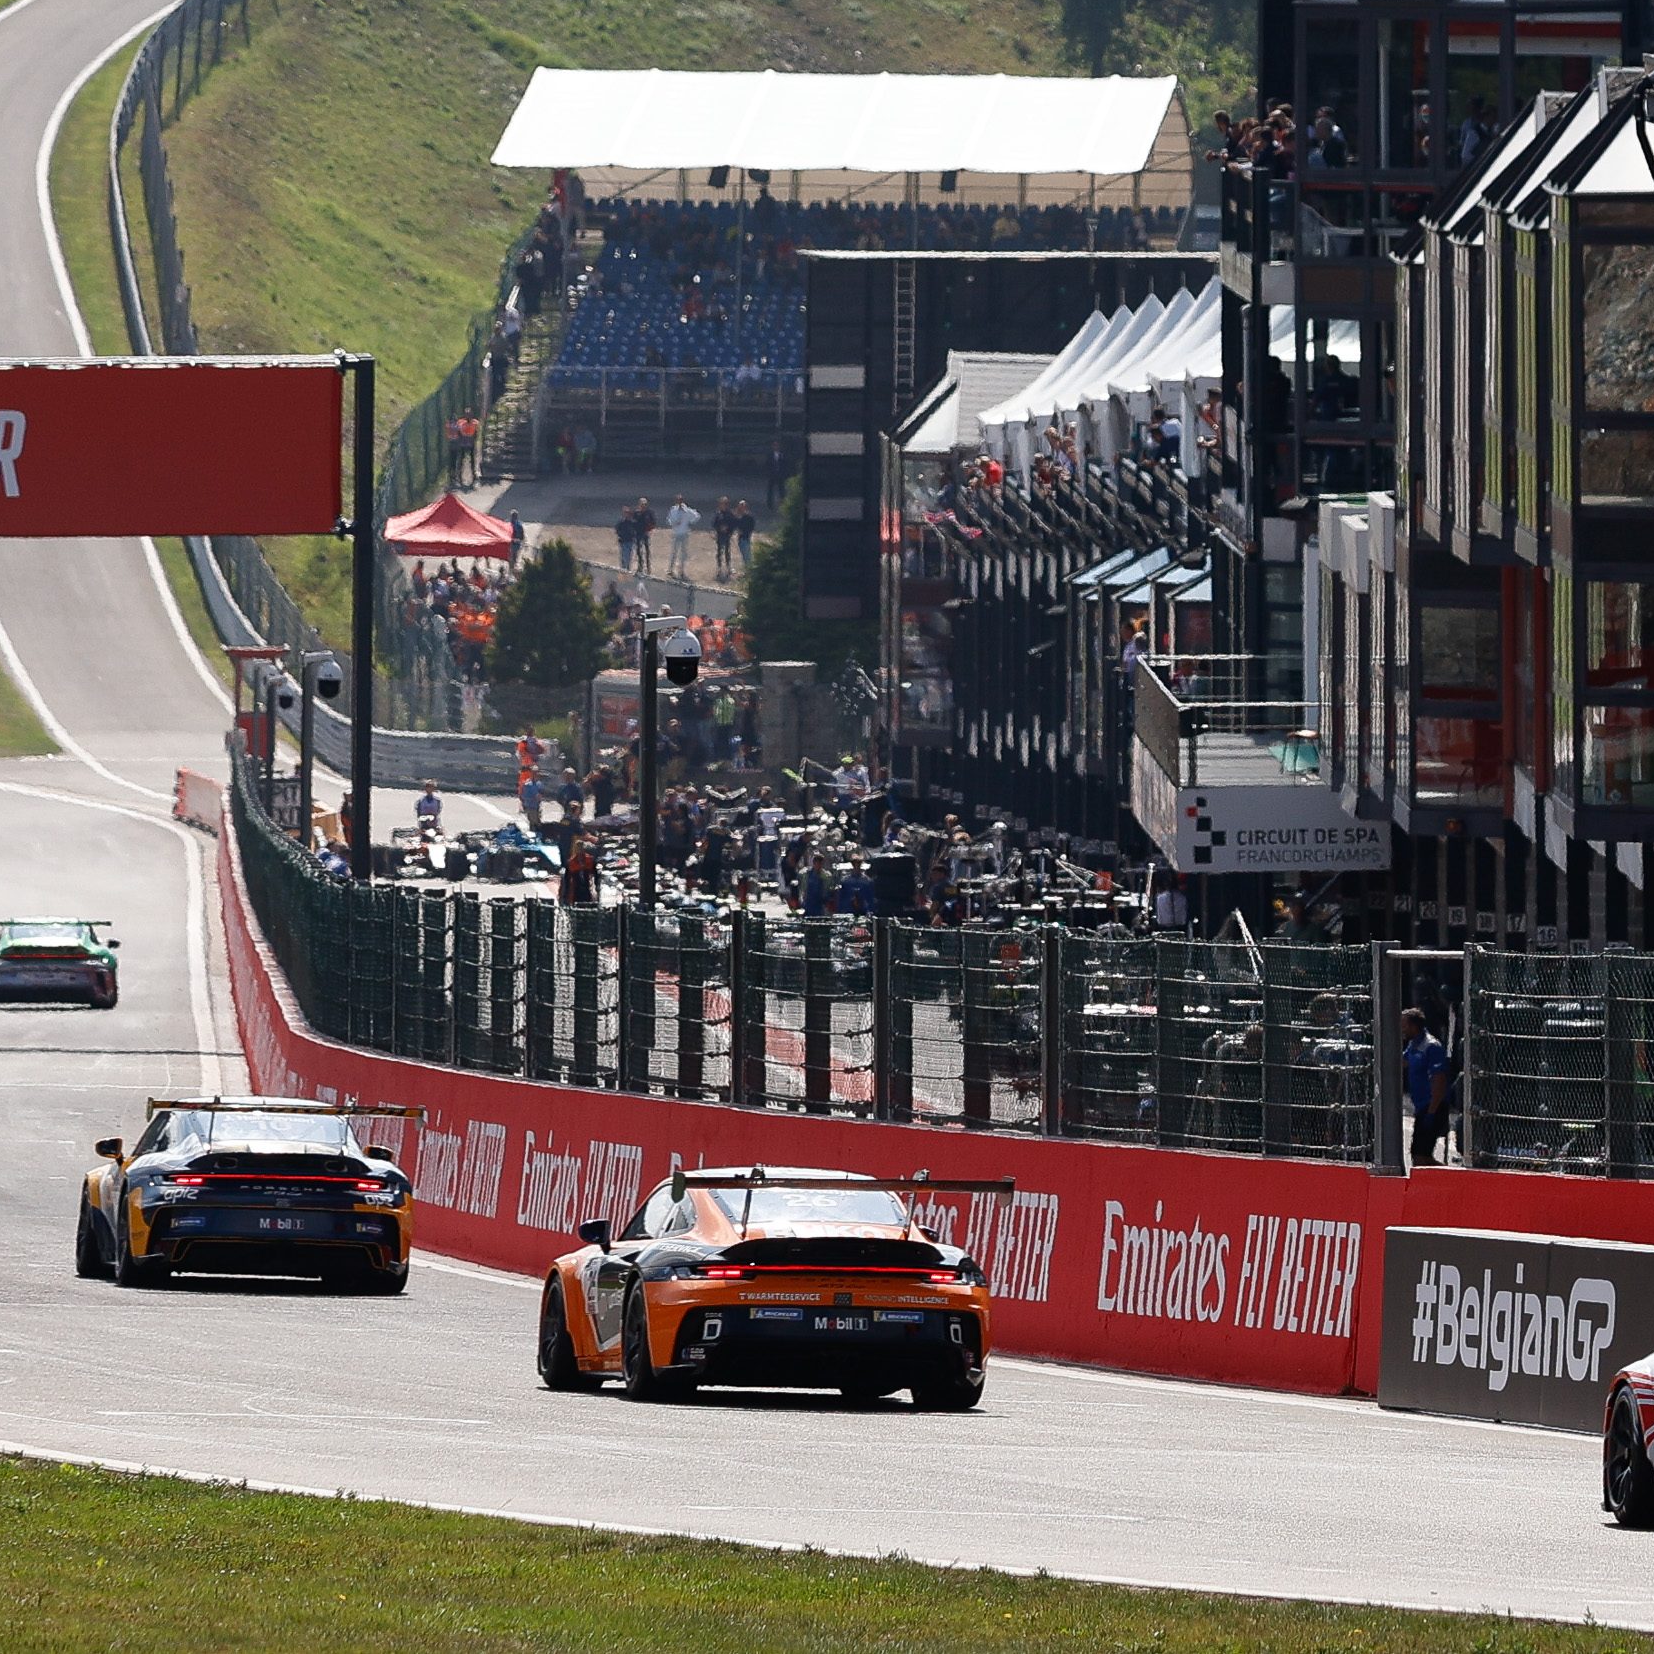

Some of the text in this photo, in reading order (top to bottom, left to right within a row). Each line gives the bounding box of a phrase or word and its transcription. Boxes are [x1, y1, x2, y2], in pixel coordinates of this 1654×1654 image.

[1237, 828, 1380, 846] CIRCUIT DE SPA
[1237, 848, 1382, 864] FRANCORCHAMPS
[780, 1193, 840, 1207] 26
[258, 1217, 291, 1231] Mobil
[1097, 1200, 1362, 1338] Emirates FLY BETTER
[814, 1317, 853, 1331] Mobil
[1412, 1260, 1616, 1392] #BelgianGP
